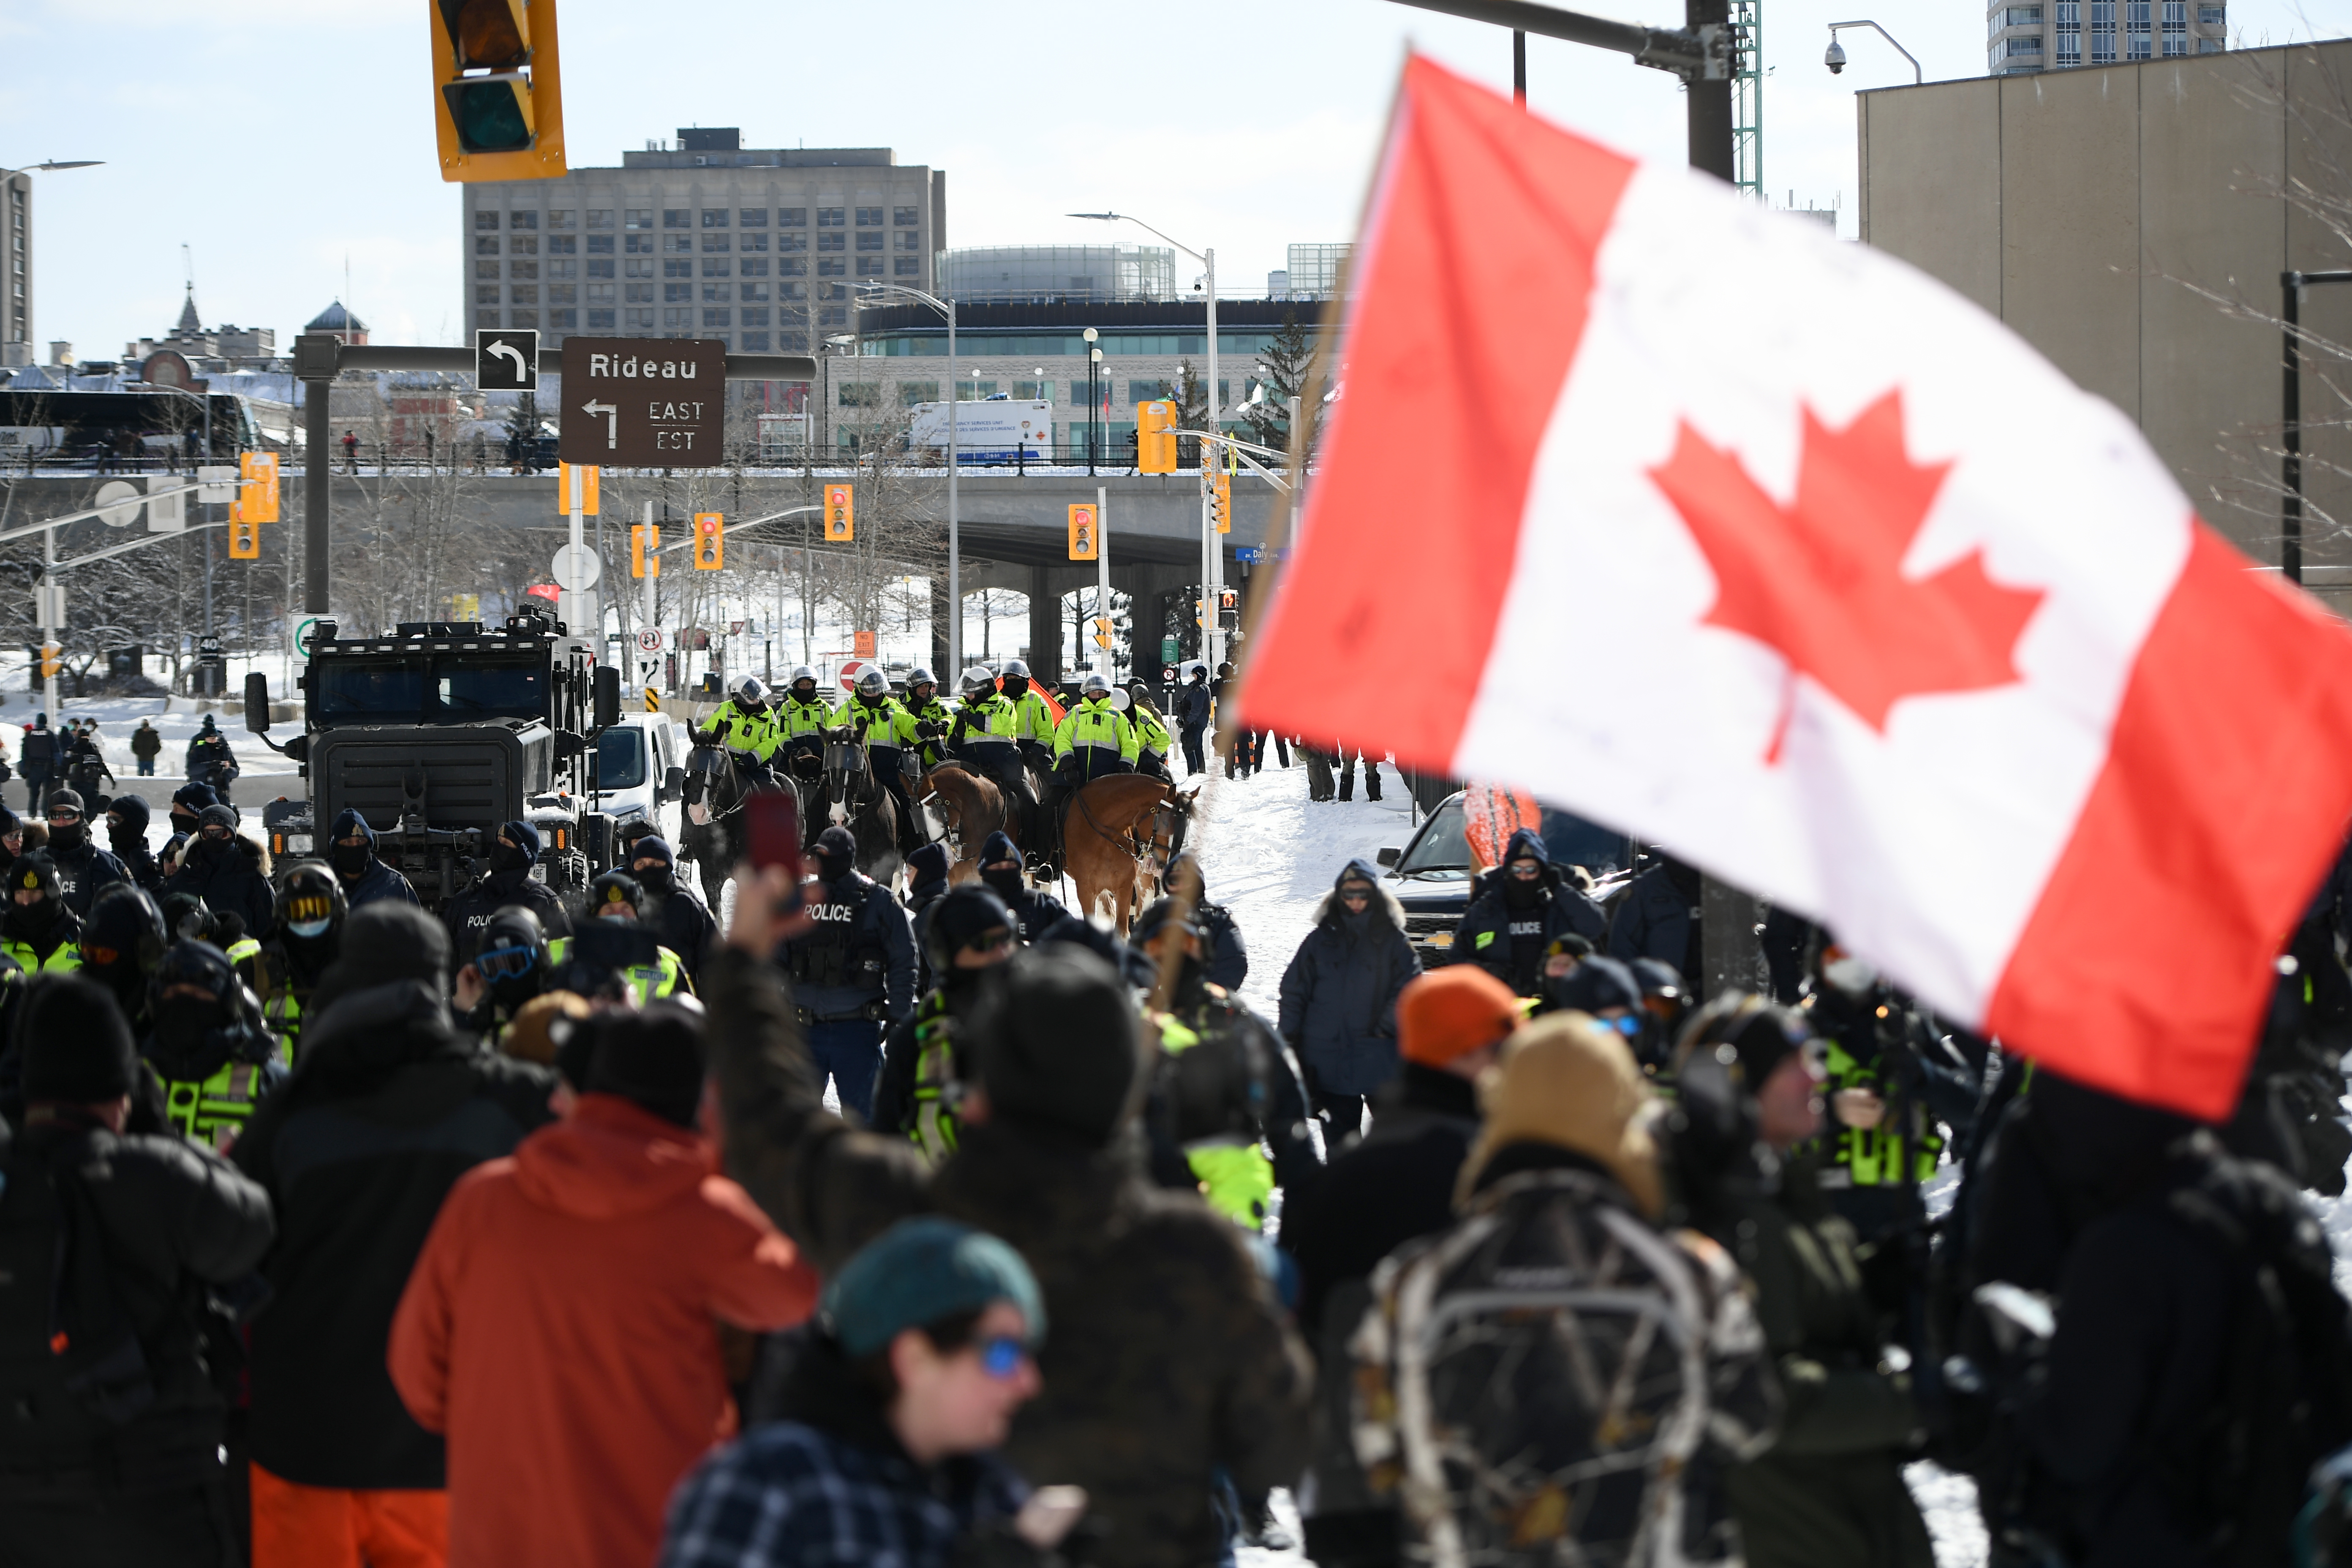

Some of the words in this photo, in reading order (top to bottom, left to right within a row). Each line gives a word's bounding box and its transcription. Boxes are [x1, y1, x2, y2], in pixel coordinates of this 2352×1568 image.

[590, 354, 697, 379] Rideau
[649, 402, 704, 420] EAST
[657, 431, 695, 449] EST
[1253, 550, 1268, 560] Daly
[200, 638, 218, 650] 40
[186, 802, 202, 813] POLIC
[520, 842, 532, 860] POLICE
[803, 904, 852, 923] POLICE
[1509, 921, 1542, 935] OLICE
[635, 969, 667, 981] POLICE
